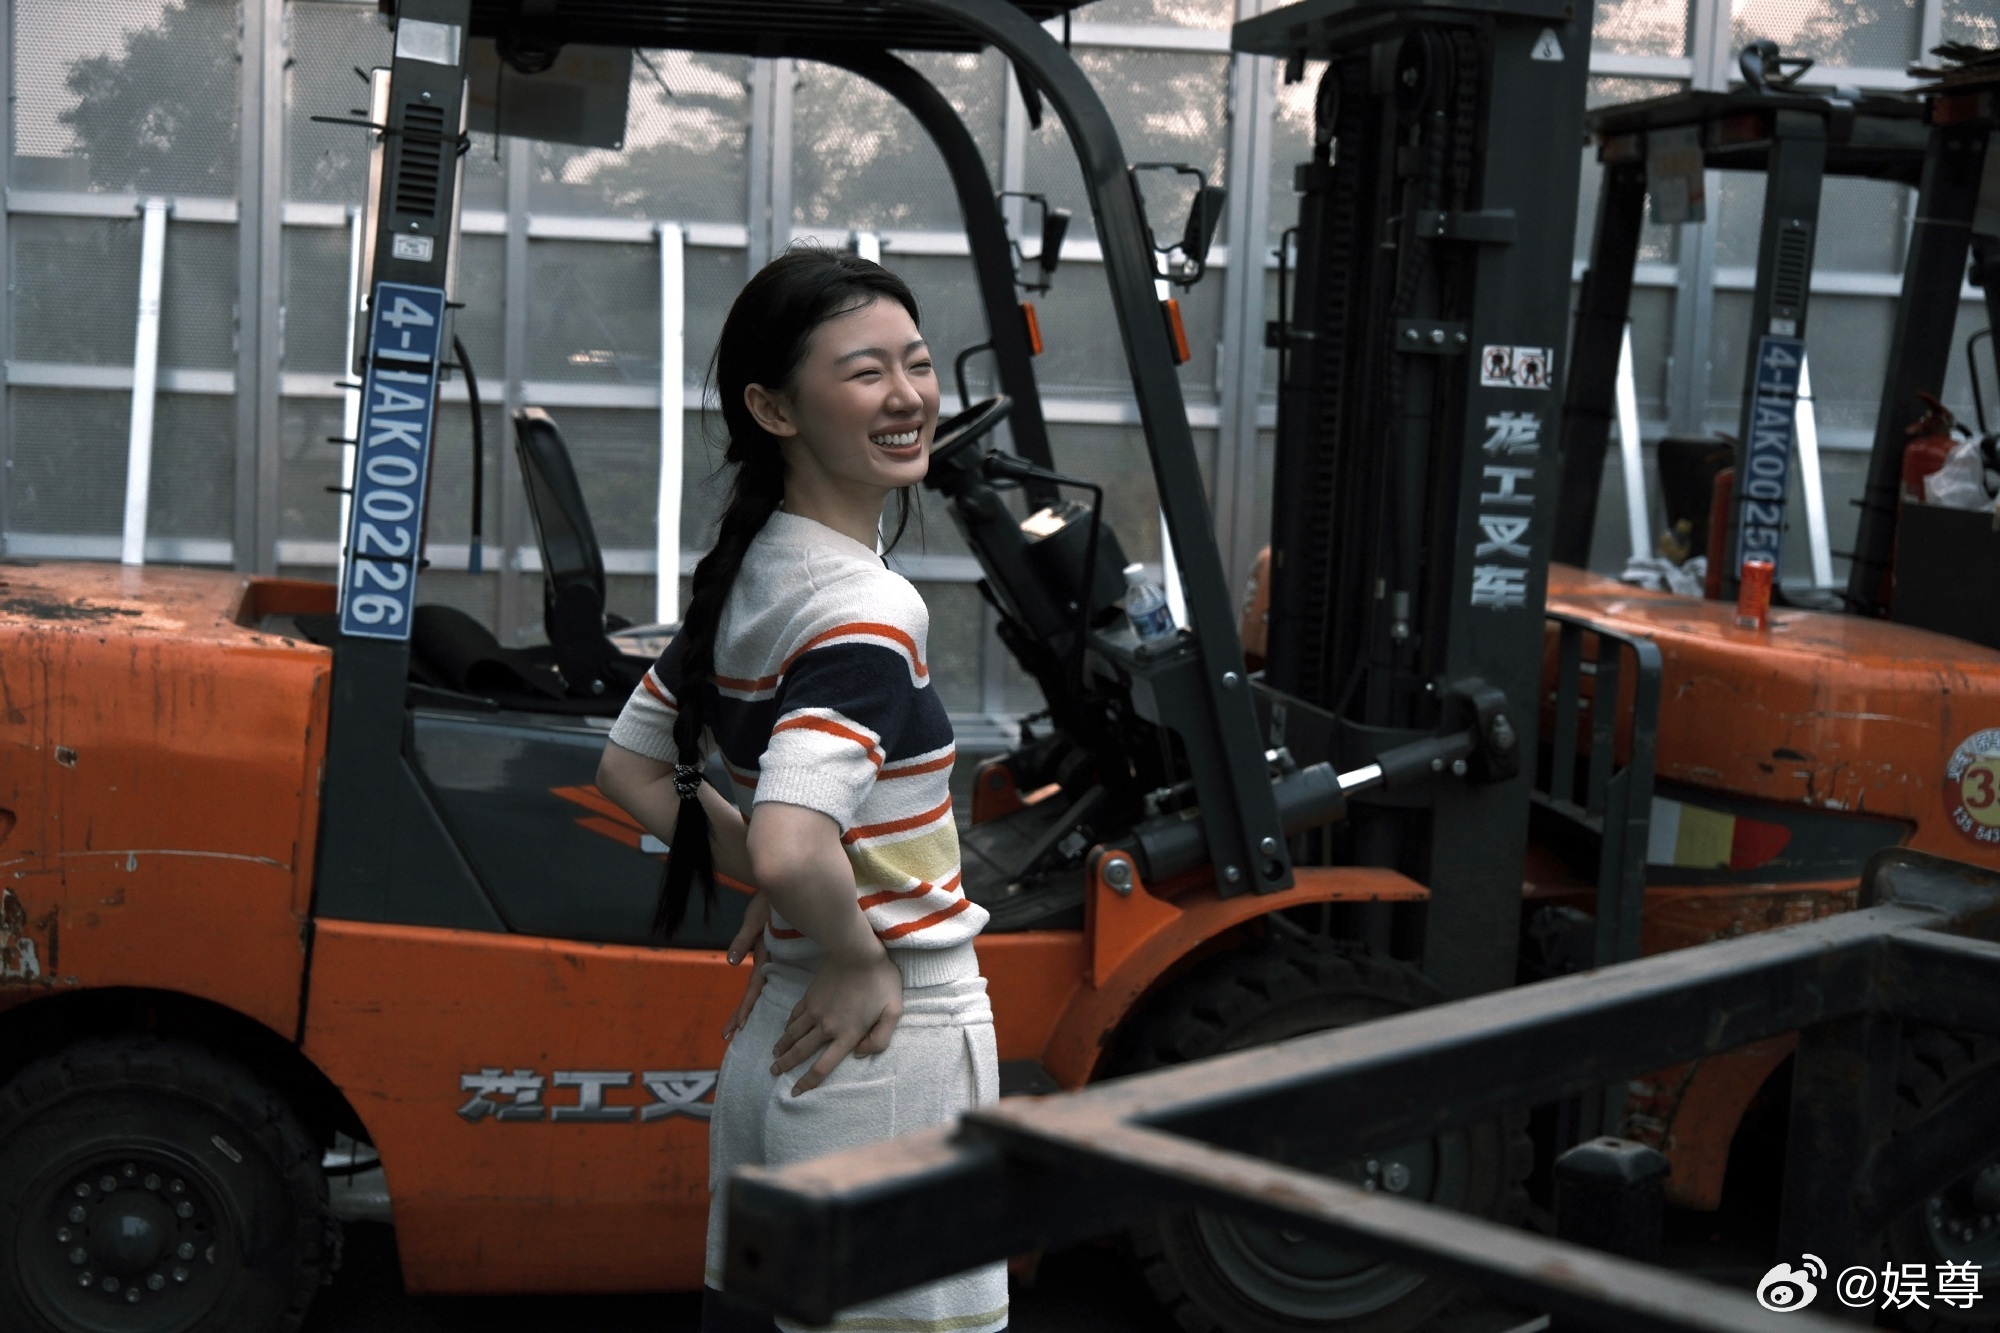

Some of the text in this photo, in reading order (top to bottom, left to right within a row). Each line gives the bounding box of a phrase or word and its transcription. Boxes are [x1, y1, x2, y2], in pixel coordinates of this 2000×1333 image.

[353, 297, 434, 624] 4-HAK00226
[1471, 411, 1542, 611] 龙工叉车
[1967, 769, 2000, 808] 3
